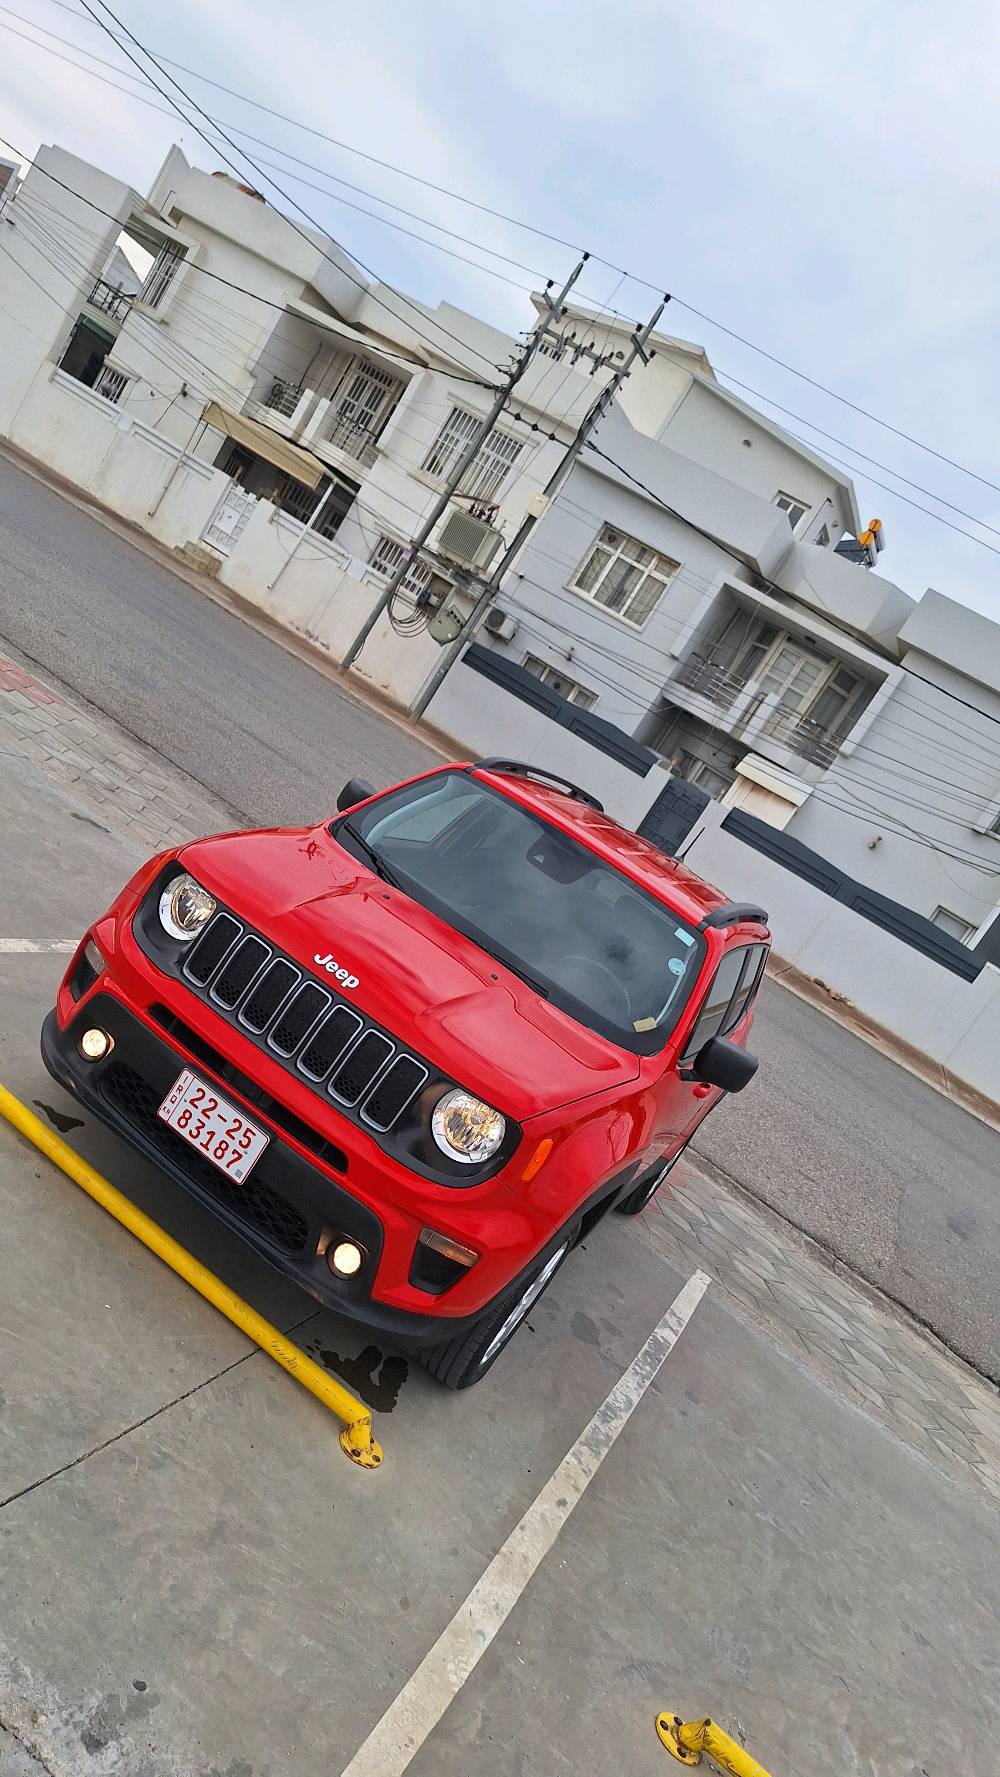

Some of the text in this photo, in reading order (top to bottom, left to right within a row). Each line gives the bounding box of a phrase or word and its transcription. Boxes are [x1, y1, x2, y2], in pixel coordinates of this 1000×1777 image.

[313, 953, 360, 988] Jeep
[176, 1108, 244, 1169] 83187
[188, 1087, 257, 1150] 22-25
